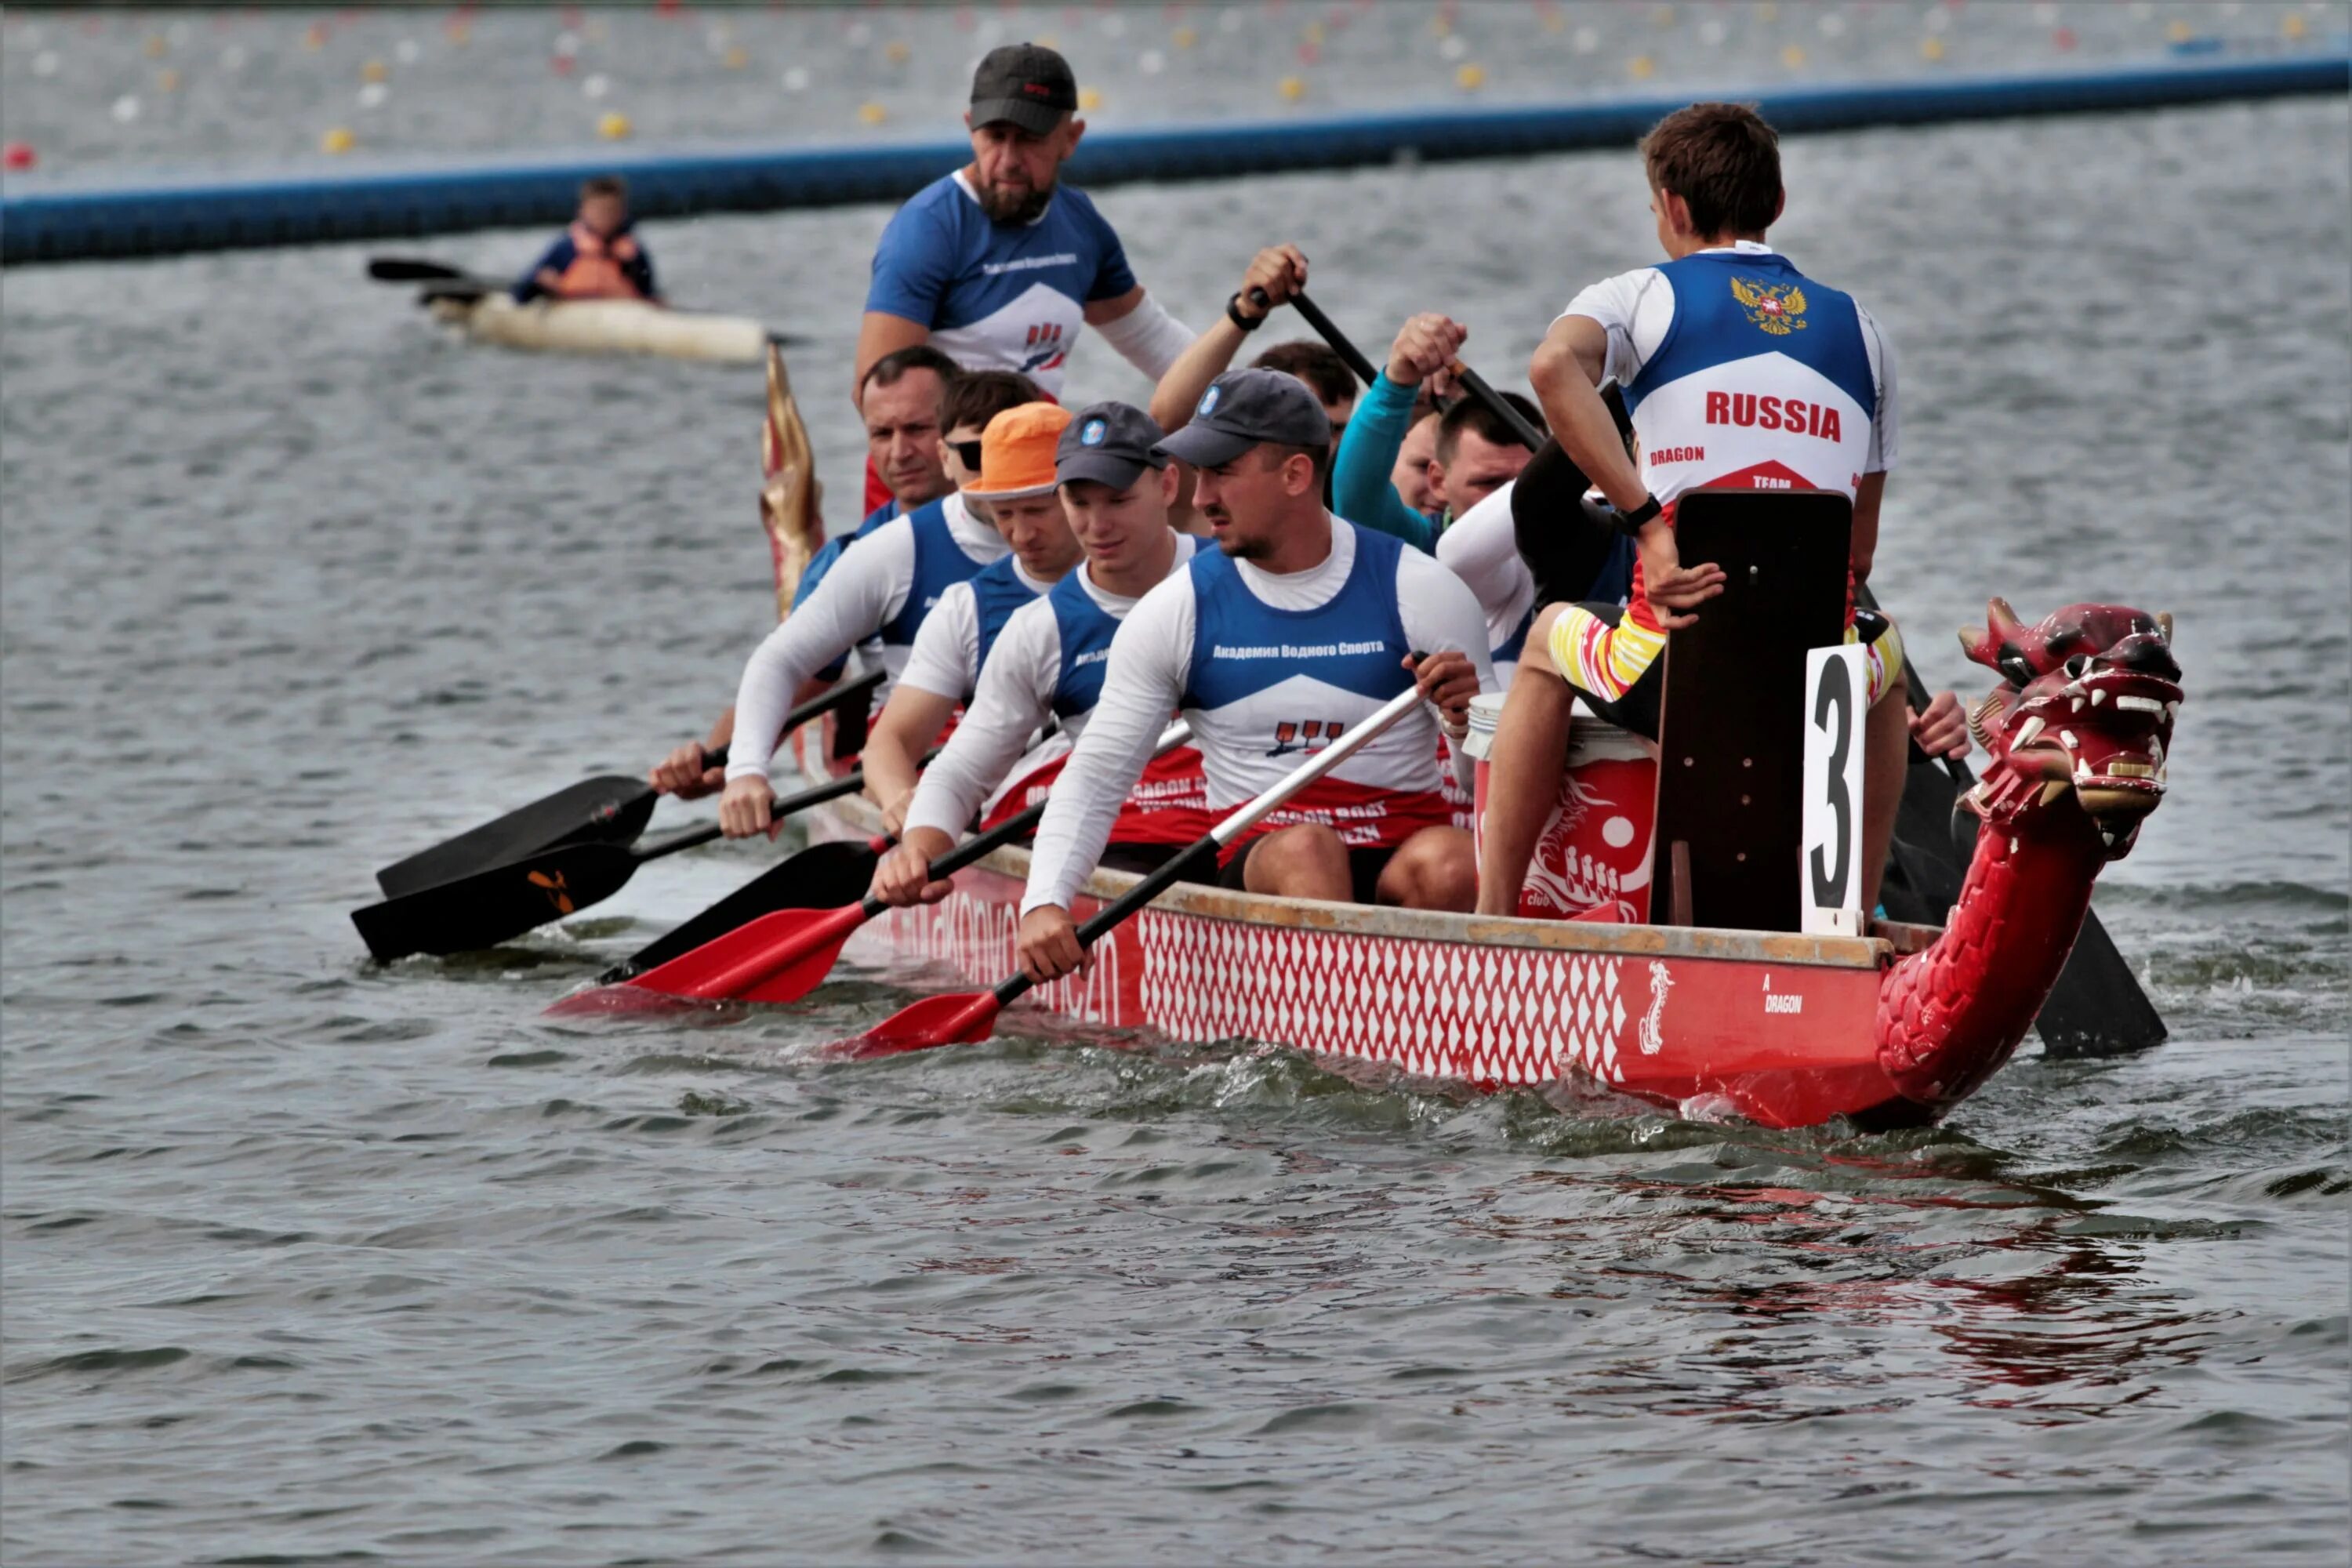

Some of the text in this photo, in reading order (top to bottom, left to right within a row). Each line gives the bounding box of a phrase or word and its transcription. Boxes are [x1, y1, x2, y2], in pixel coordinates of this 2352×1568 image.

[1706, 391, 1841, 443] RUSSIA
[1650, 446, 1704, 466] DRAGON
[1214, 641, 1385, 660] Академия Водного Спорта
[1810, 654, 1852, 909] 3
[1527, 893, 1549, 907] club
[1762, 973, 1770, 992] A
[1765, 994, 1802, 1014] DRAGON
